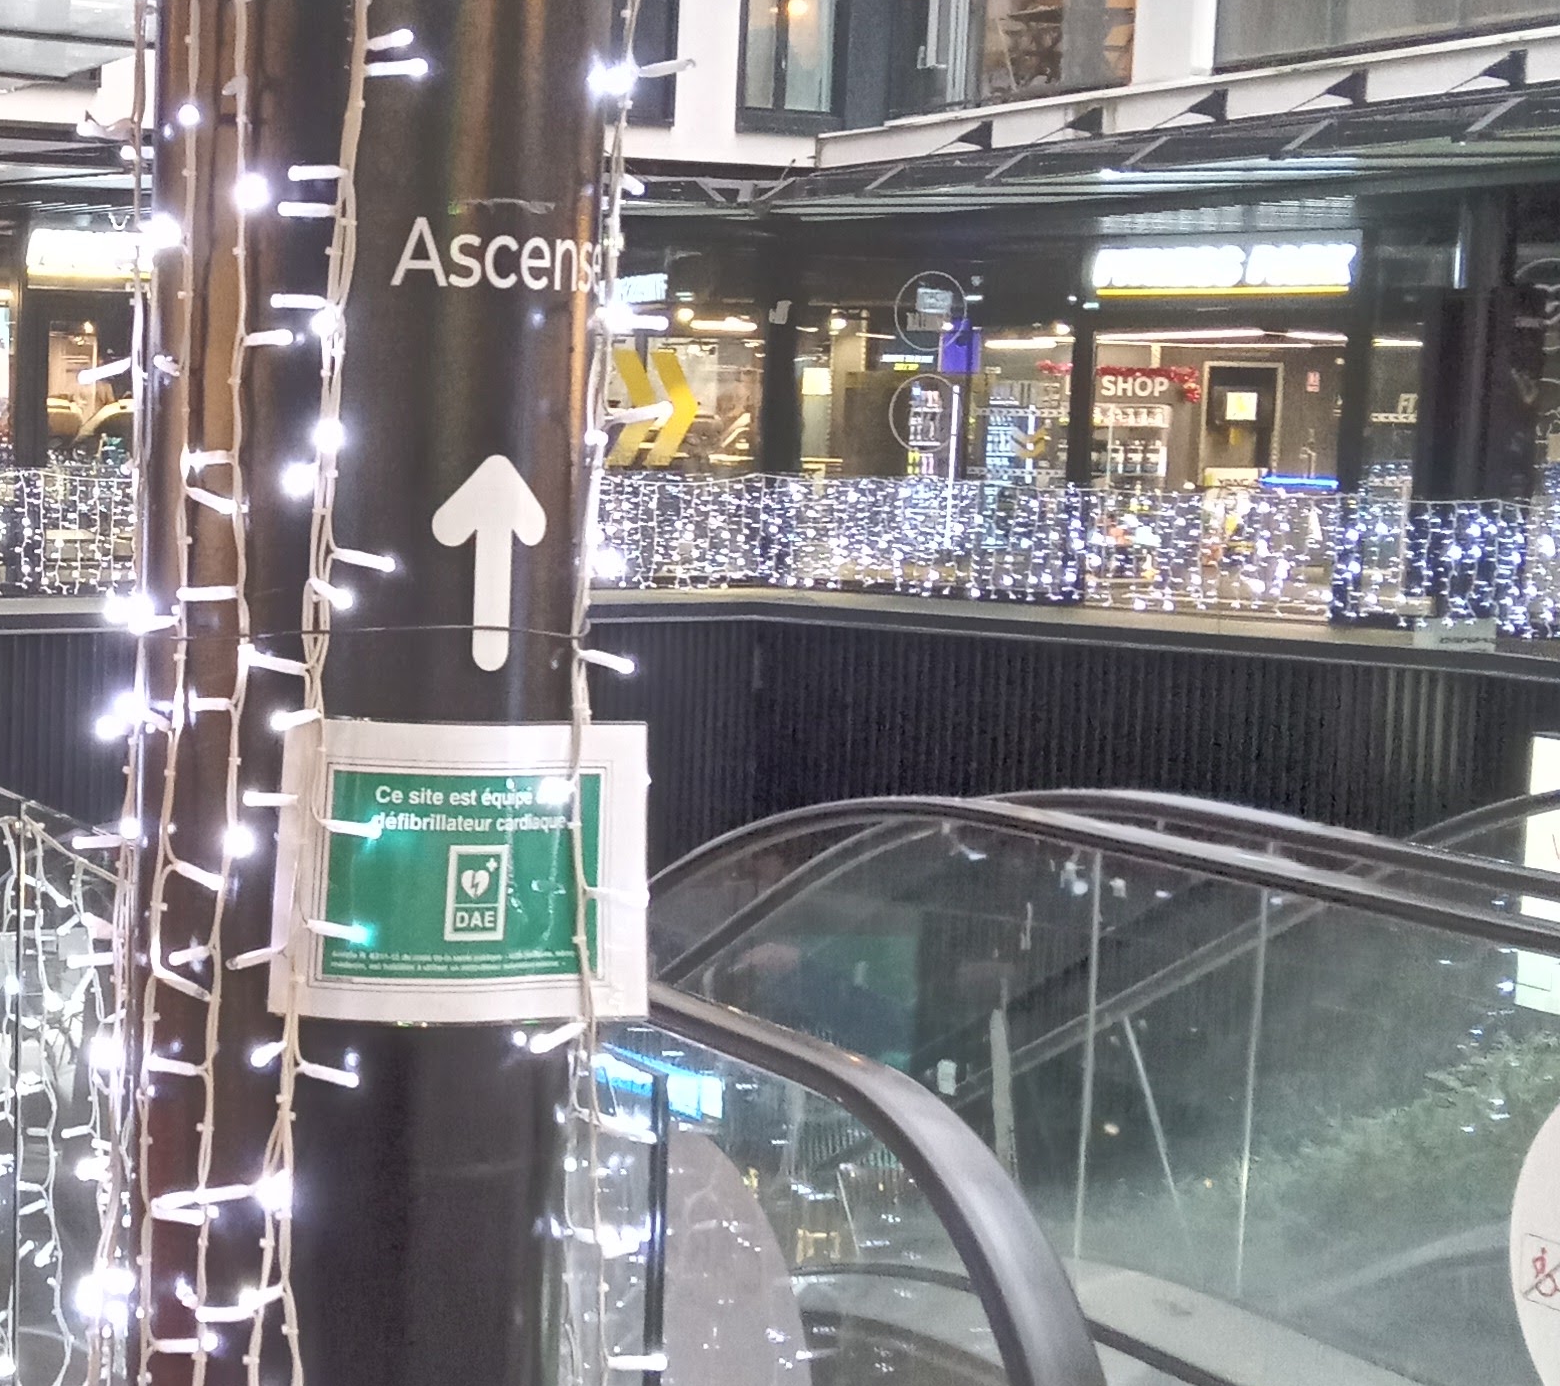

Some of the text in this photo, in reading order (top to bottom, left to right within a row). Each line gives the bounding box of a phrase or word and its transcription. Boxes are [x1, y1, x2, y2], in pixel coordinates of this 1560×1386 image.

[1100, 375, 1170, 398] SHOP
[375, 785, 405, 804] Ce
[408, 786, 444, 806] site
[449, 790, 477, 806] est
[373, 811, 493, 833] défibrillateur
[455, 910, 495, 929] DAE
